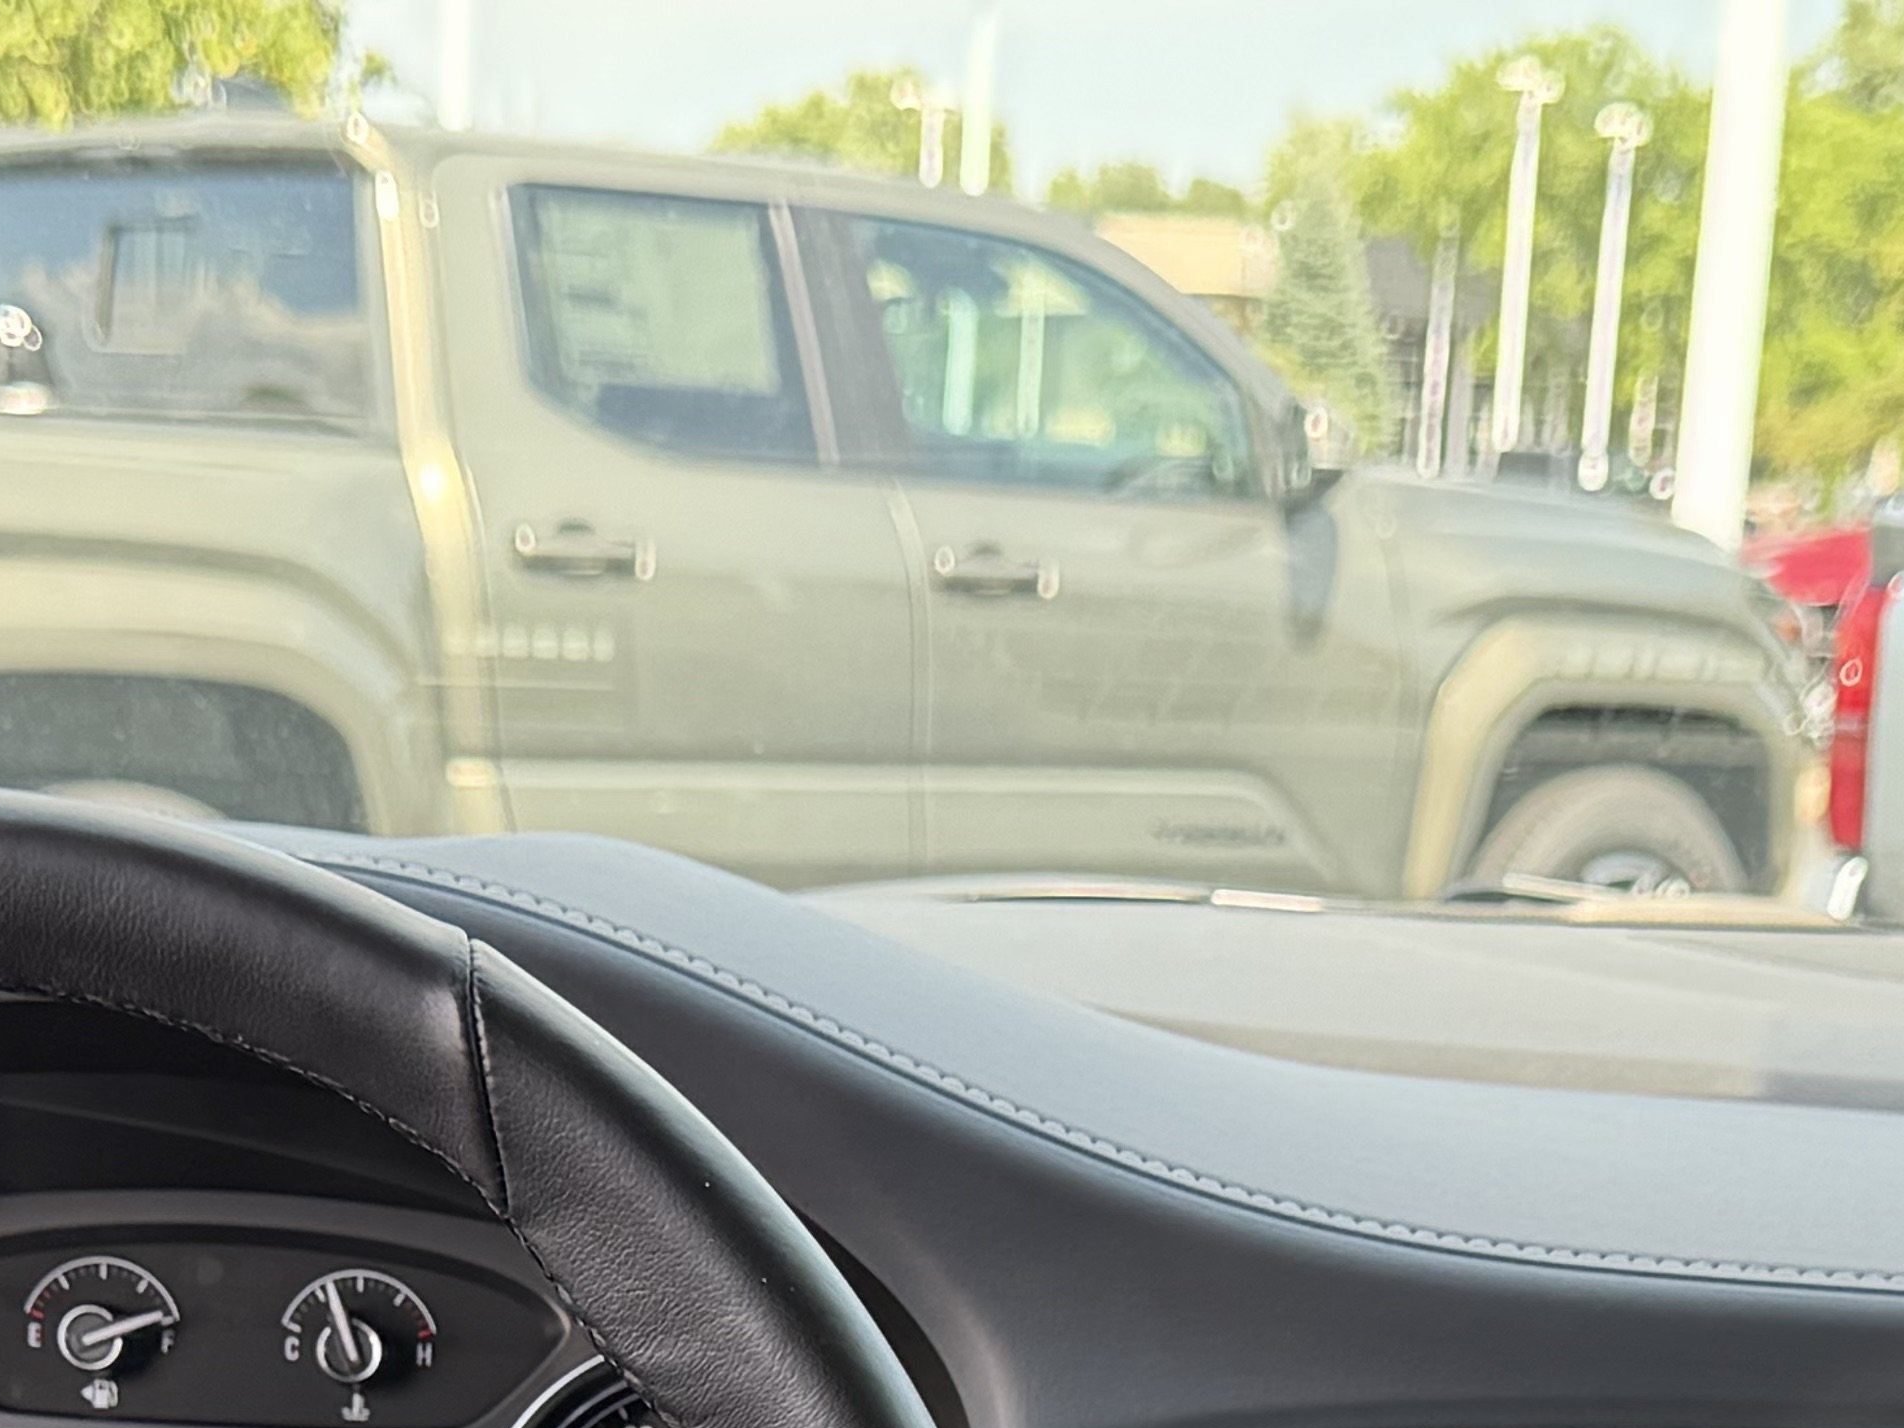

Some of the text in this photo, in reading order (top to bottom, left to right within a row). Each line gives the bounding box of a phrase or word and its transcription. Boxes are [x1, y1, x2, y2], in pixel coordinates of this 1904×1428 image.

[28, 1322, 42, 1349] E
[285, 1337, 300, 1362] C
[416, 1343, 432, 1368] H
